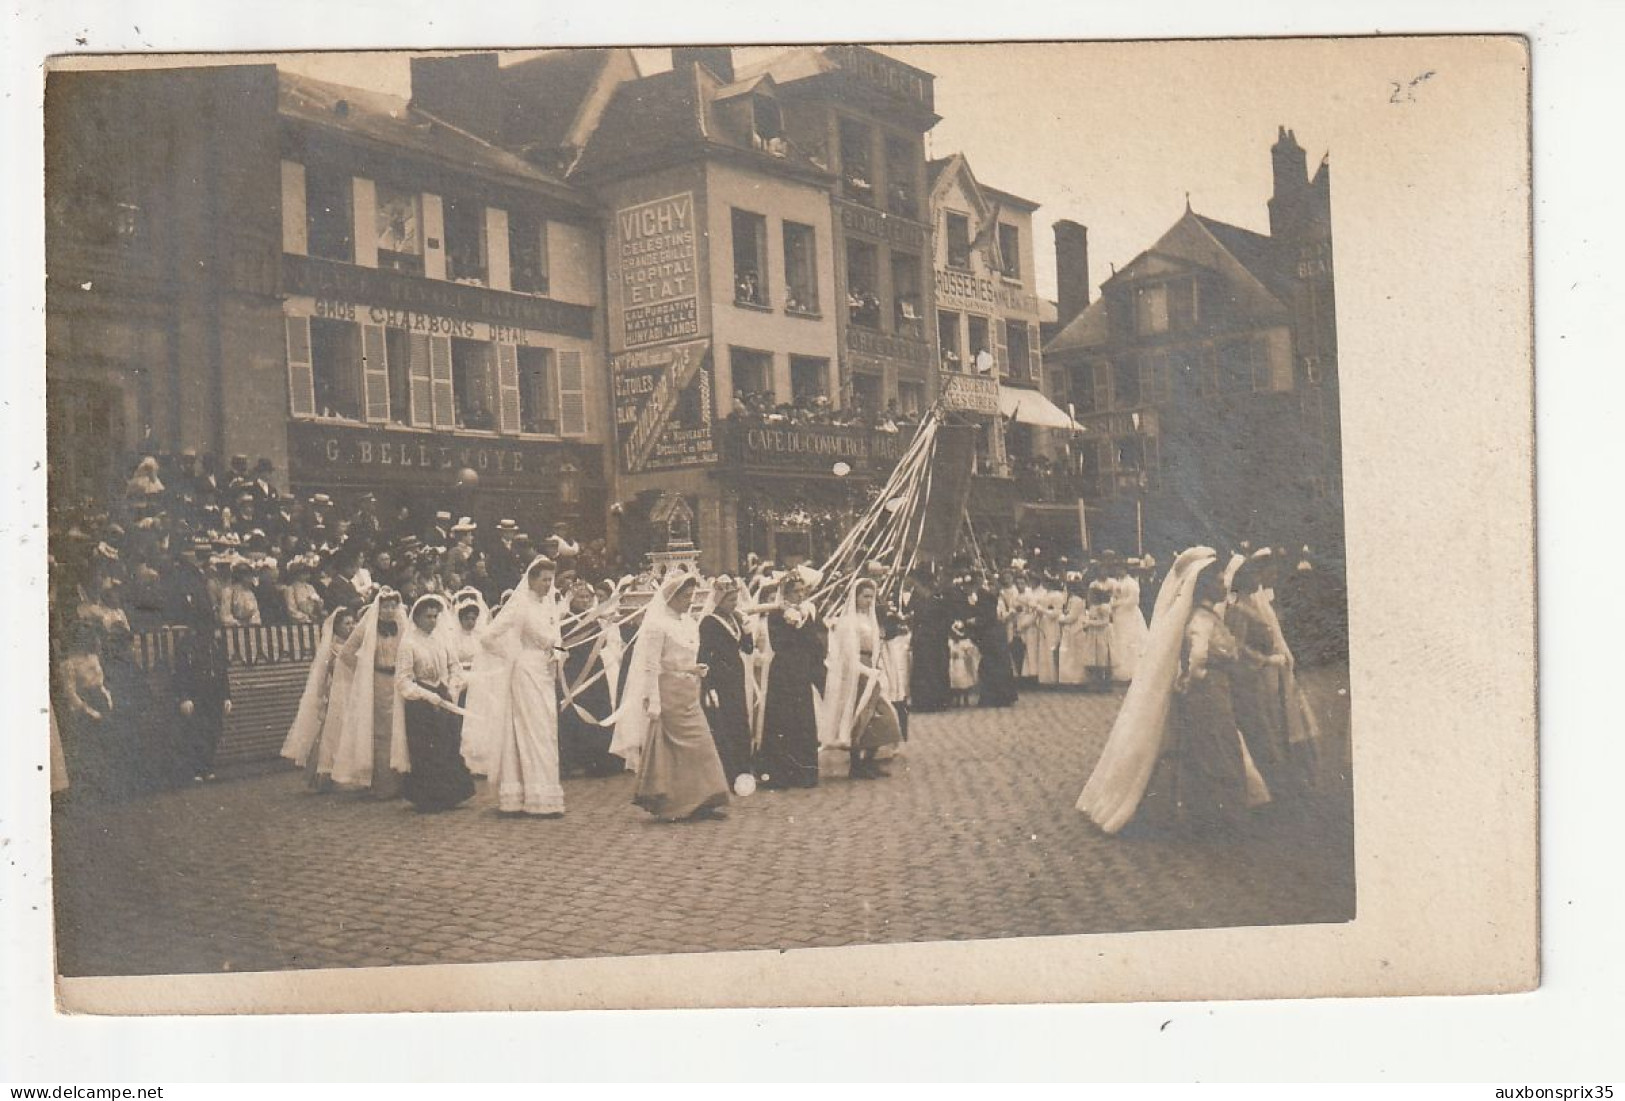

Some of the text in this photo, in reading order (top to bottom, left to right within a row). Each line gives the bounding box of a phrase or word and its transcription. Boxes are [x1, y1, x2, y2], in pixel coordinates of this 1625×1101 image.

[622, 199, 690, 240] VICHY
[622, 230, 693, 256] CELESTINS
[625, 261, 691, 284] HOPITAL
[631, 277, 685, 302] ETAT
[936, 269, 992, 303] ROSSERIES
[315, 299, 529, 346] GROS CHARBONS DETAIL
[627, 311, 695, 330] NATURELLE
[645, 301, 695, 318] PURGATIVE
[748, 429, 784, 450] CAFE
[787, 432, 803, 451] DU
[806, 433, 866, 456] COMMERCE
[357, 440, 525, 472] BELLEVOYE
